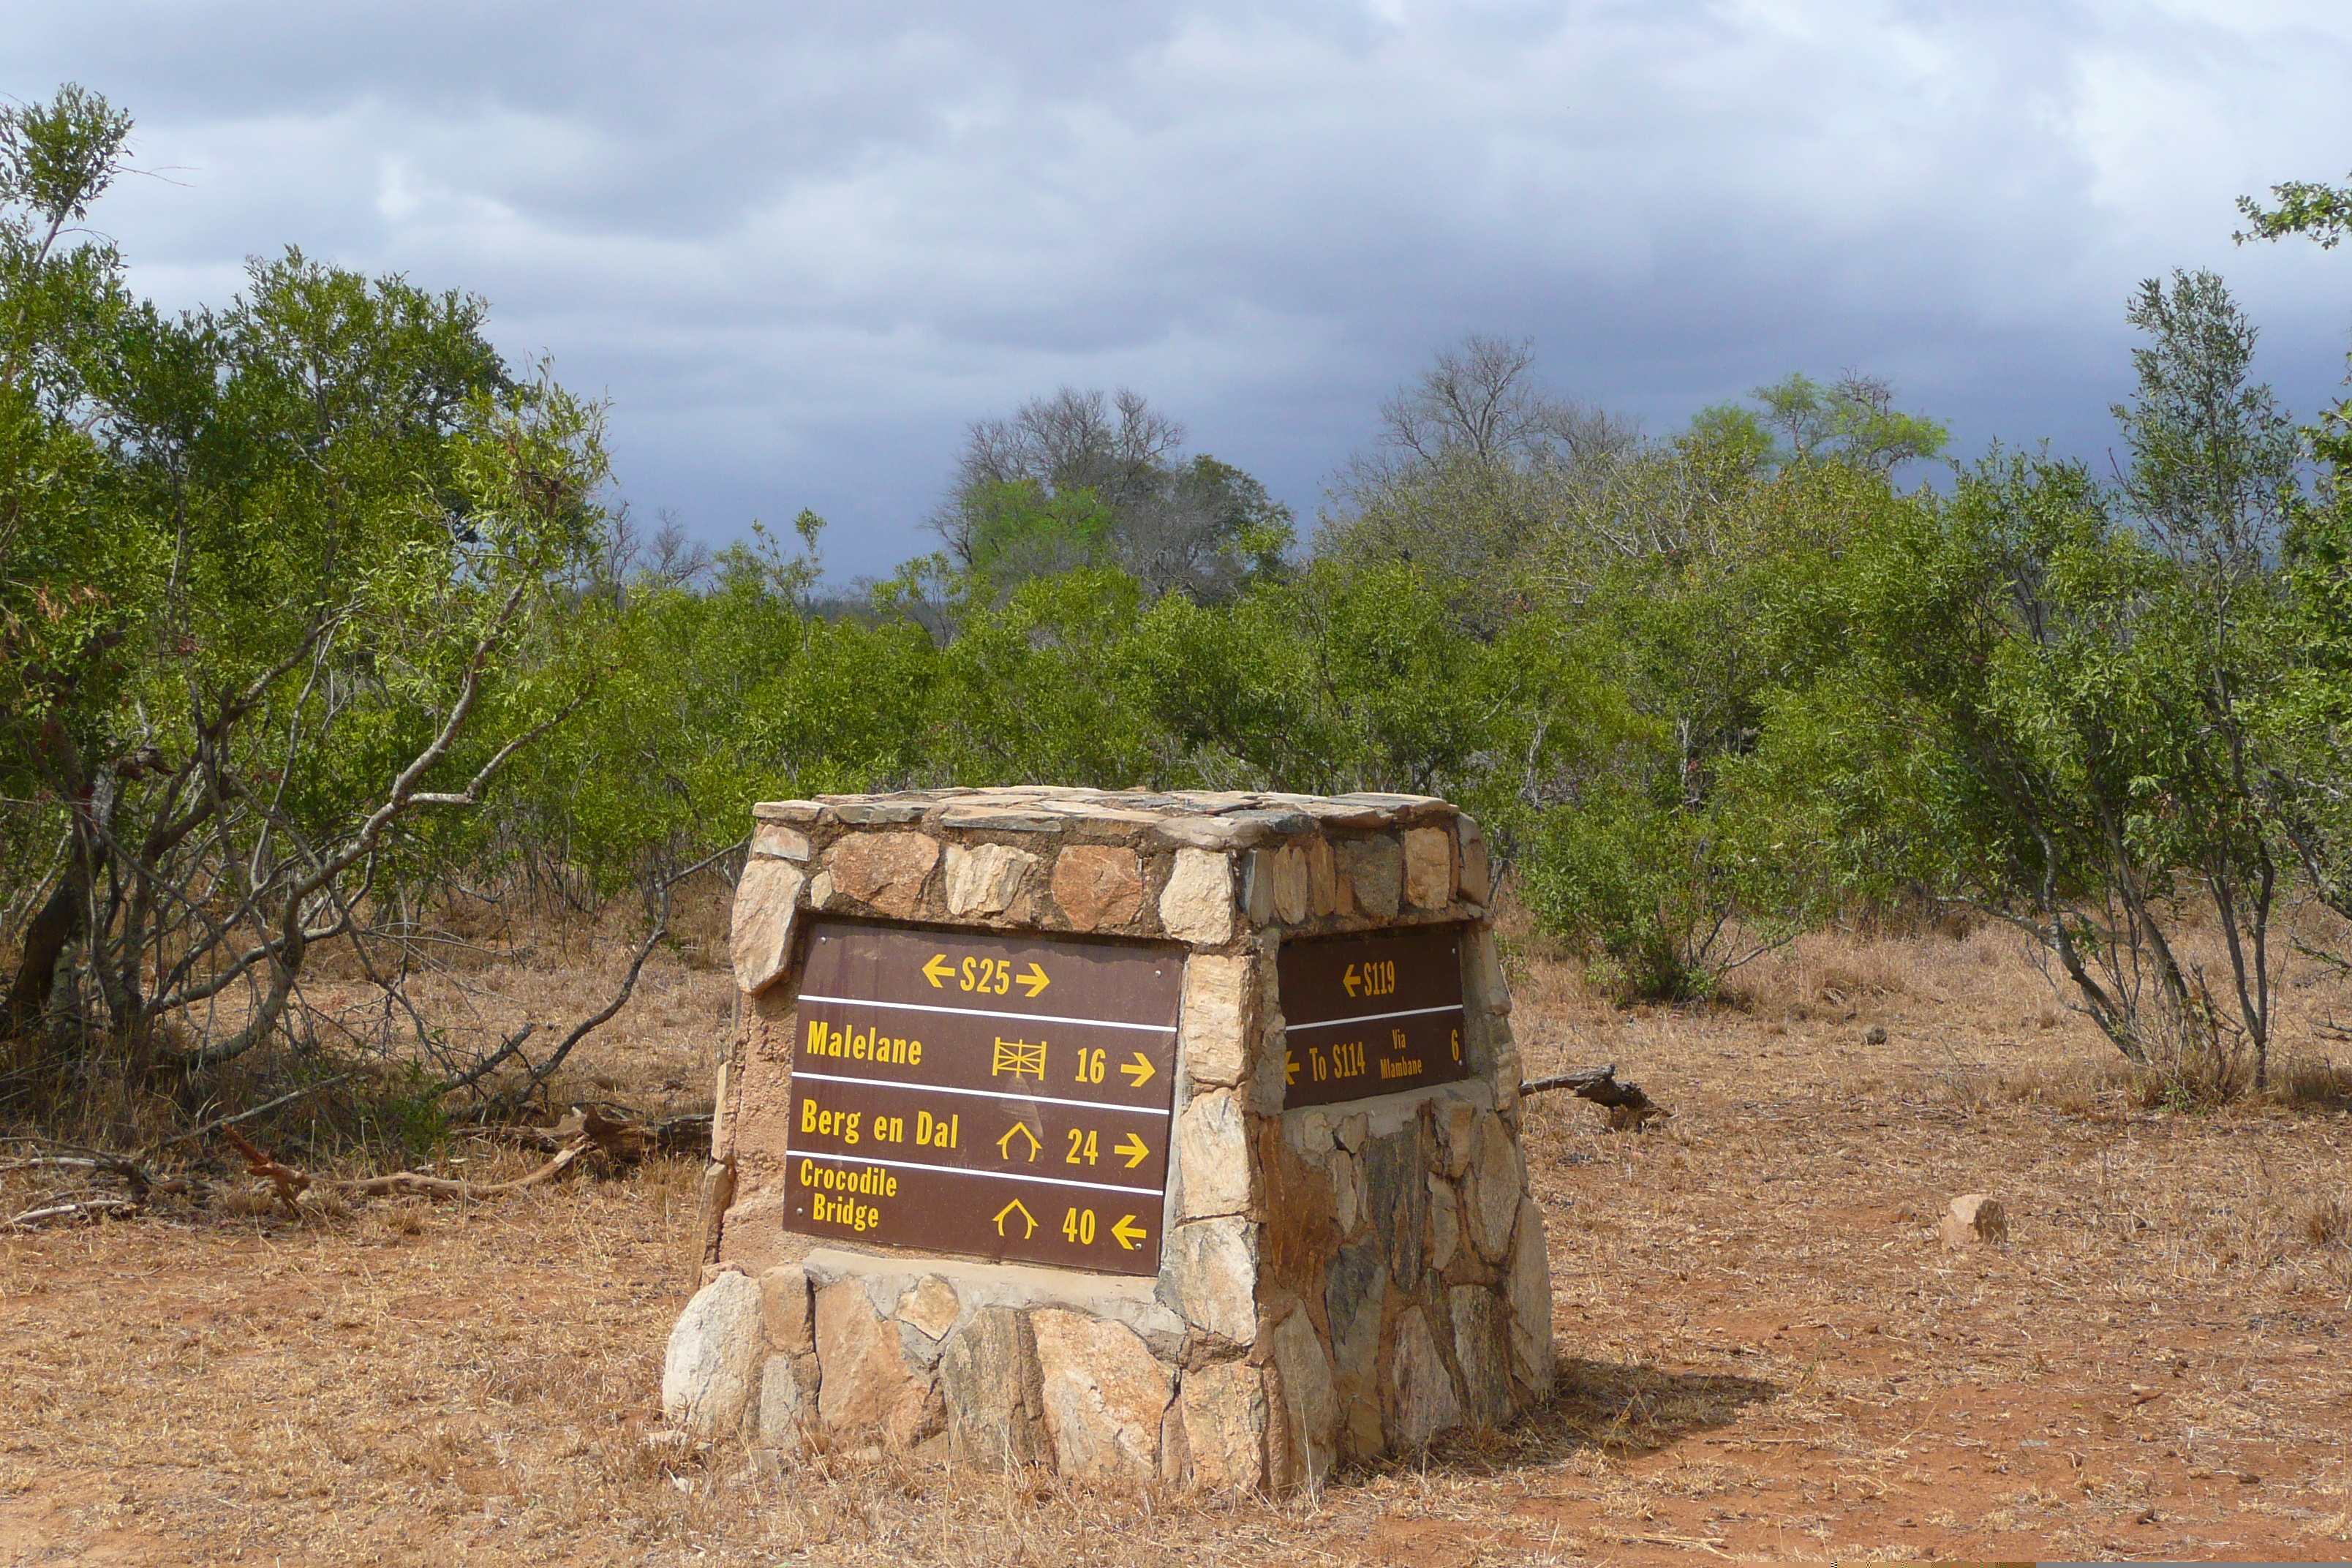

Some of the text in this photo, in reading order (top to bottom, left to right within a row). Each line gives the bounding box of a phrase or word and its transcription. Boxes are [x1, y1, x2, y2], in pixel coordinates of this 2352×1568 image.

[960, 956, 1011, 995] S25
[1364, 960, 1395, 996] S119
[807, 1020, 1106, 1084] Malelane 16
[1392, 1029, 1406, 1049] Via
[1451, 1029, 1460, 1061] 6
[1309, 1041, 1366, 1081] To S114
[1380, 1057, 1422, 1079] Mlambane
[802, 1098, 1098, 1165] Berg en Dal 24
[800, 1158, 897, 1197] Crocodile
[813, 1193, 879, 1232] Bridge
[1063, 1207, 1096, 1245] 40
